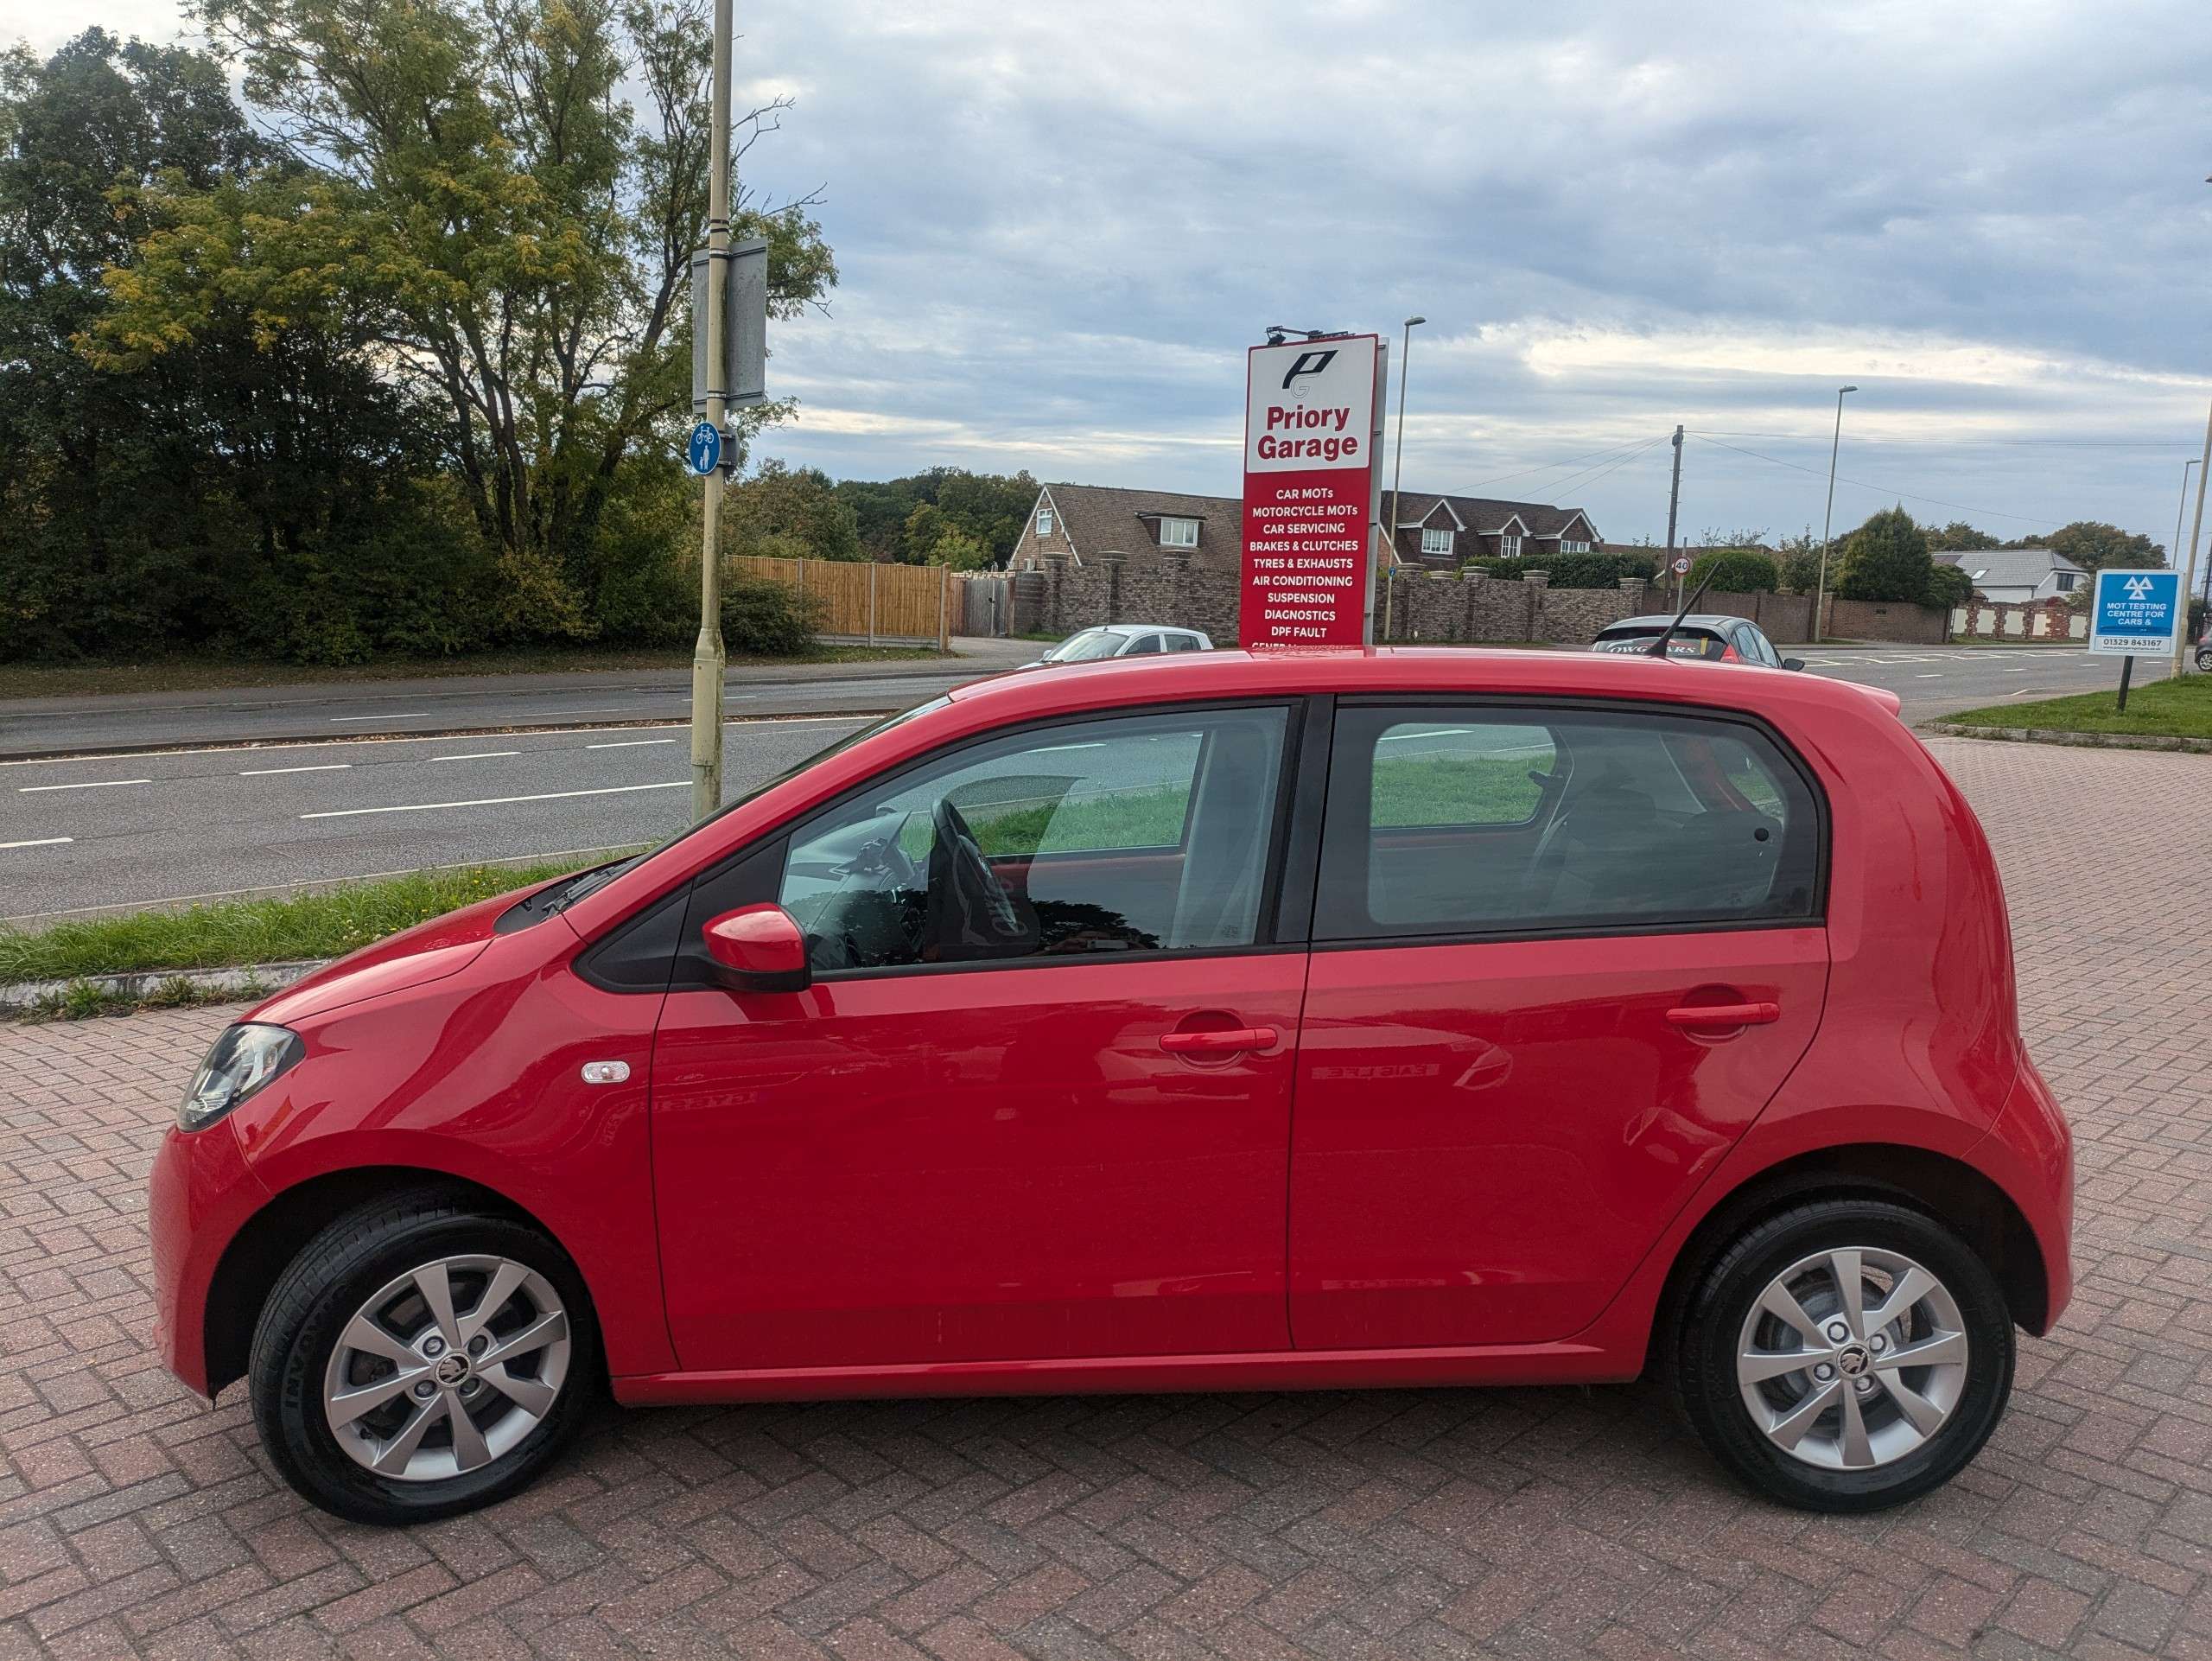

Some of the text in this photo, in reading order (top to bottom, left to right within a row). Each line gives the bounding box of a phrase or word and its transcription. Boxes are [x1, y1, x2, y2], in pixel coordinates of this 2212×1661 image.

[1267, 404, 1351, 431] Priory
[1257, 435, 1358, 461] Garage
[1276, 488, 1334, 500] CAR MOTs
[1253, 505, 1358, 518] MOTORCYCLE MOTs
[1263, 523, 1345, 534] CAR SERVICING
[1249, 540, 1359, 551] BRAKES & CLUTCHES
[1254, 558, 1354, 569] TYRES & EXHAUSTS
[1252, 576, 1353, 587] AIR CONDITIONING
[1268, 593, 1335, 604] SUSPENSION
[1264, 609, 1336, 621] DIAGNOSTICS
[1271, 626, 1327, 638] DPF FAULT
